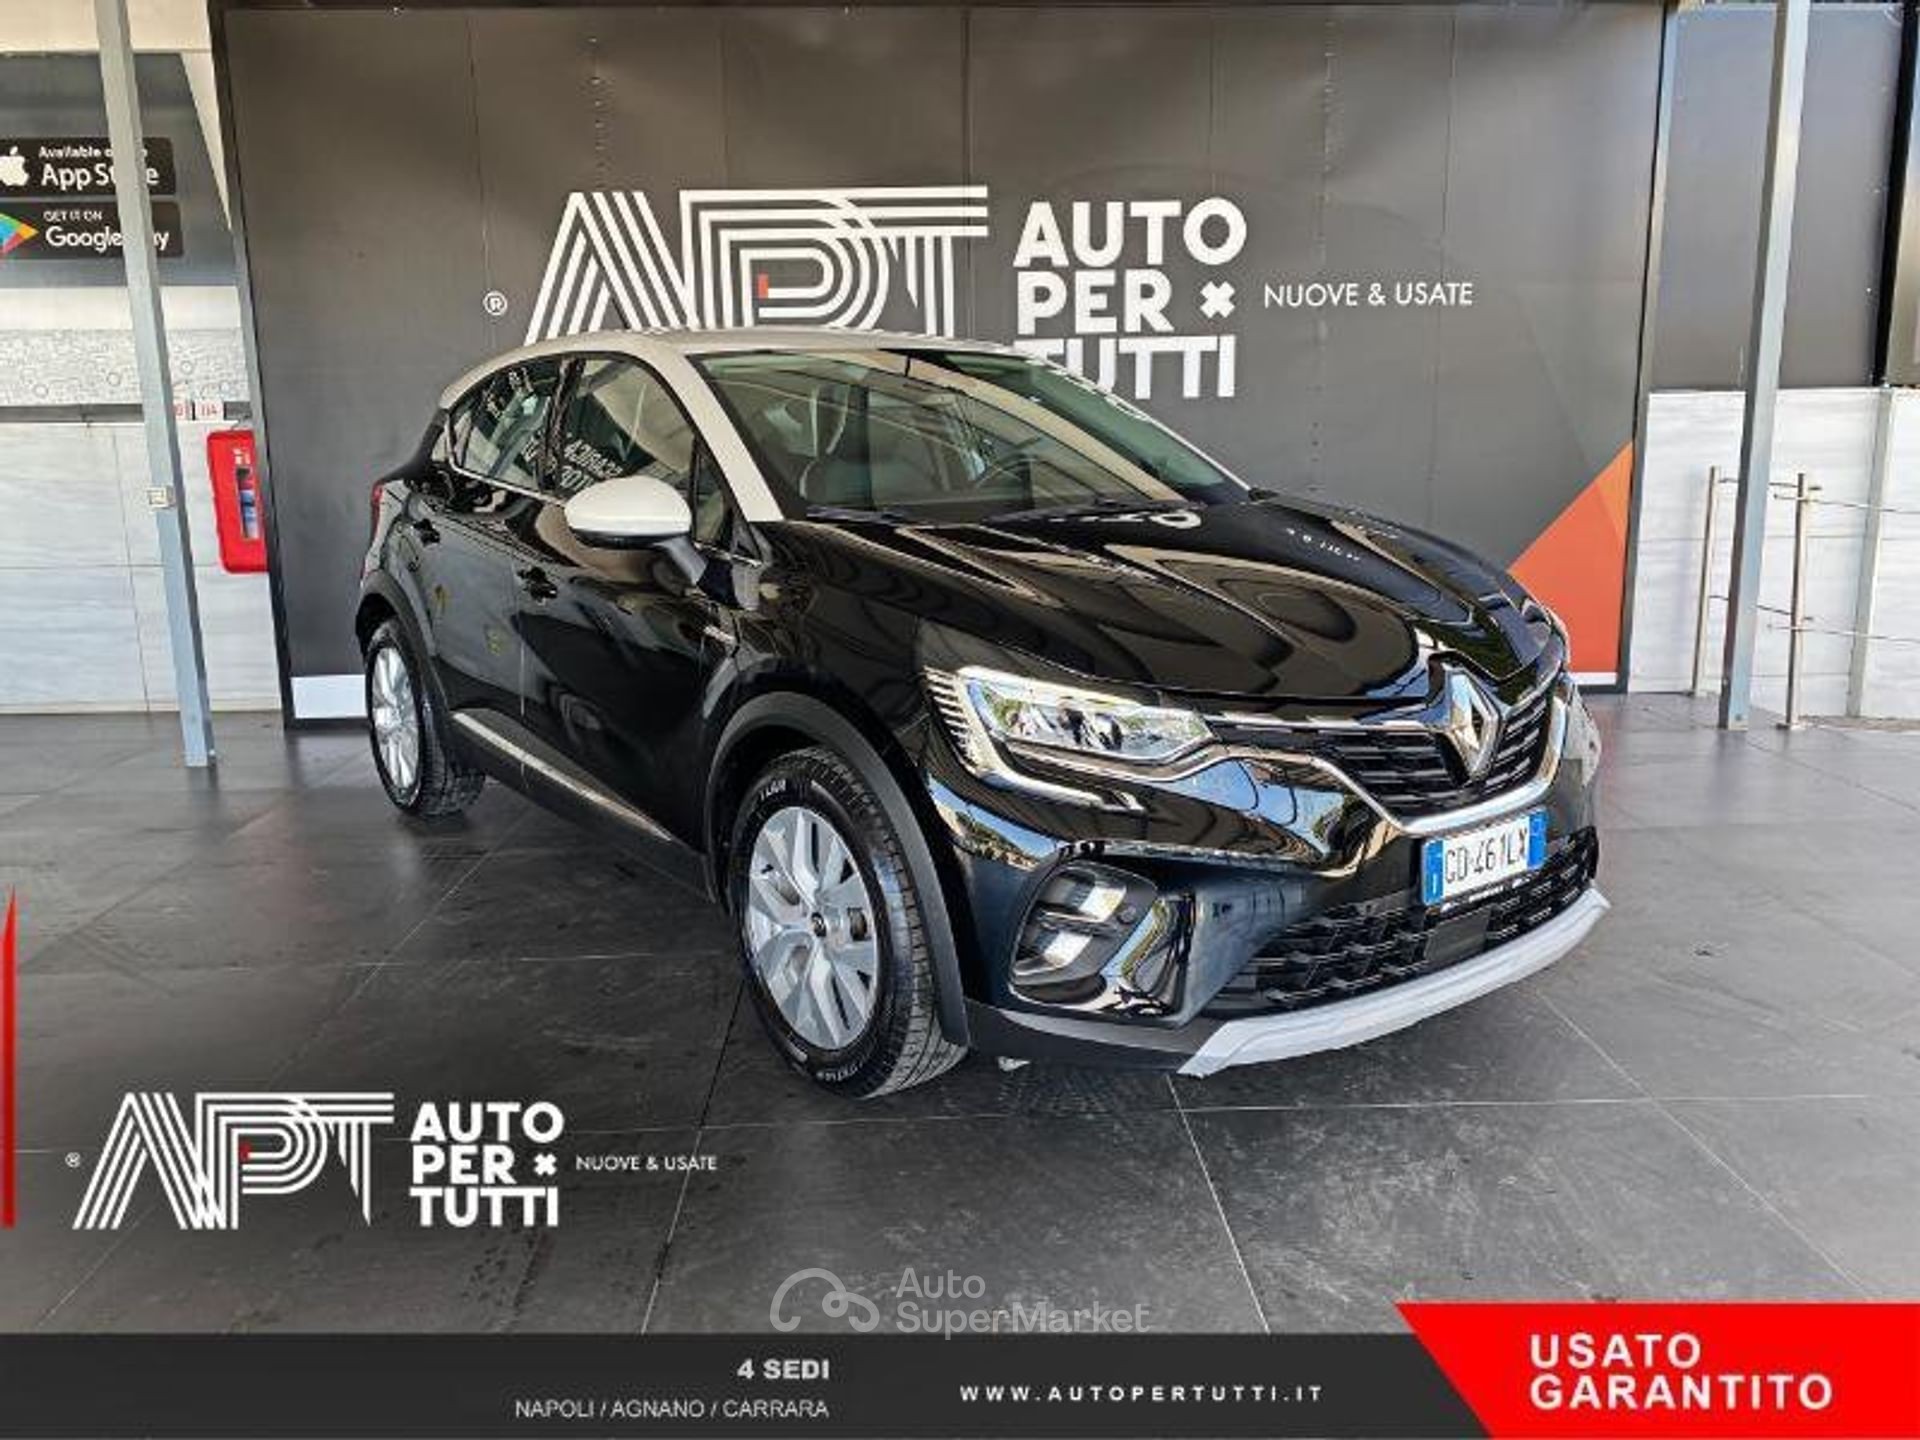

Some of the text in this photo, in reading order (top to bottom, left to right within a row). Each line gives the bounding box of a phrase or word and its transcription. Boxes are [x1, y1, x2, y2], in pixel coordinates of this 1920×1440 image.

[41, 163, 92, 191] App
[45, 226, 124, 253] Google
[1013, 197, 1247, 268] AUTO
[1017, 268, 1175, 335] PER
[1264, 281, 1474, 309] NUOVE & USATE
